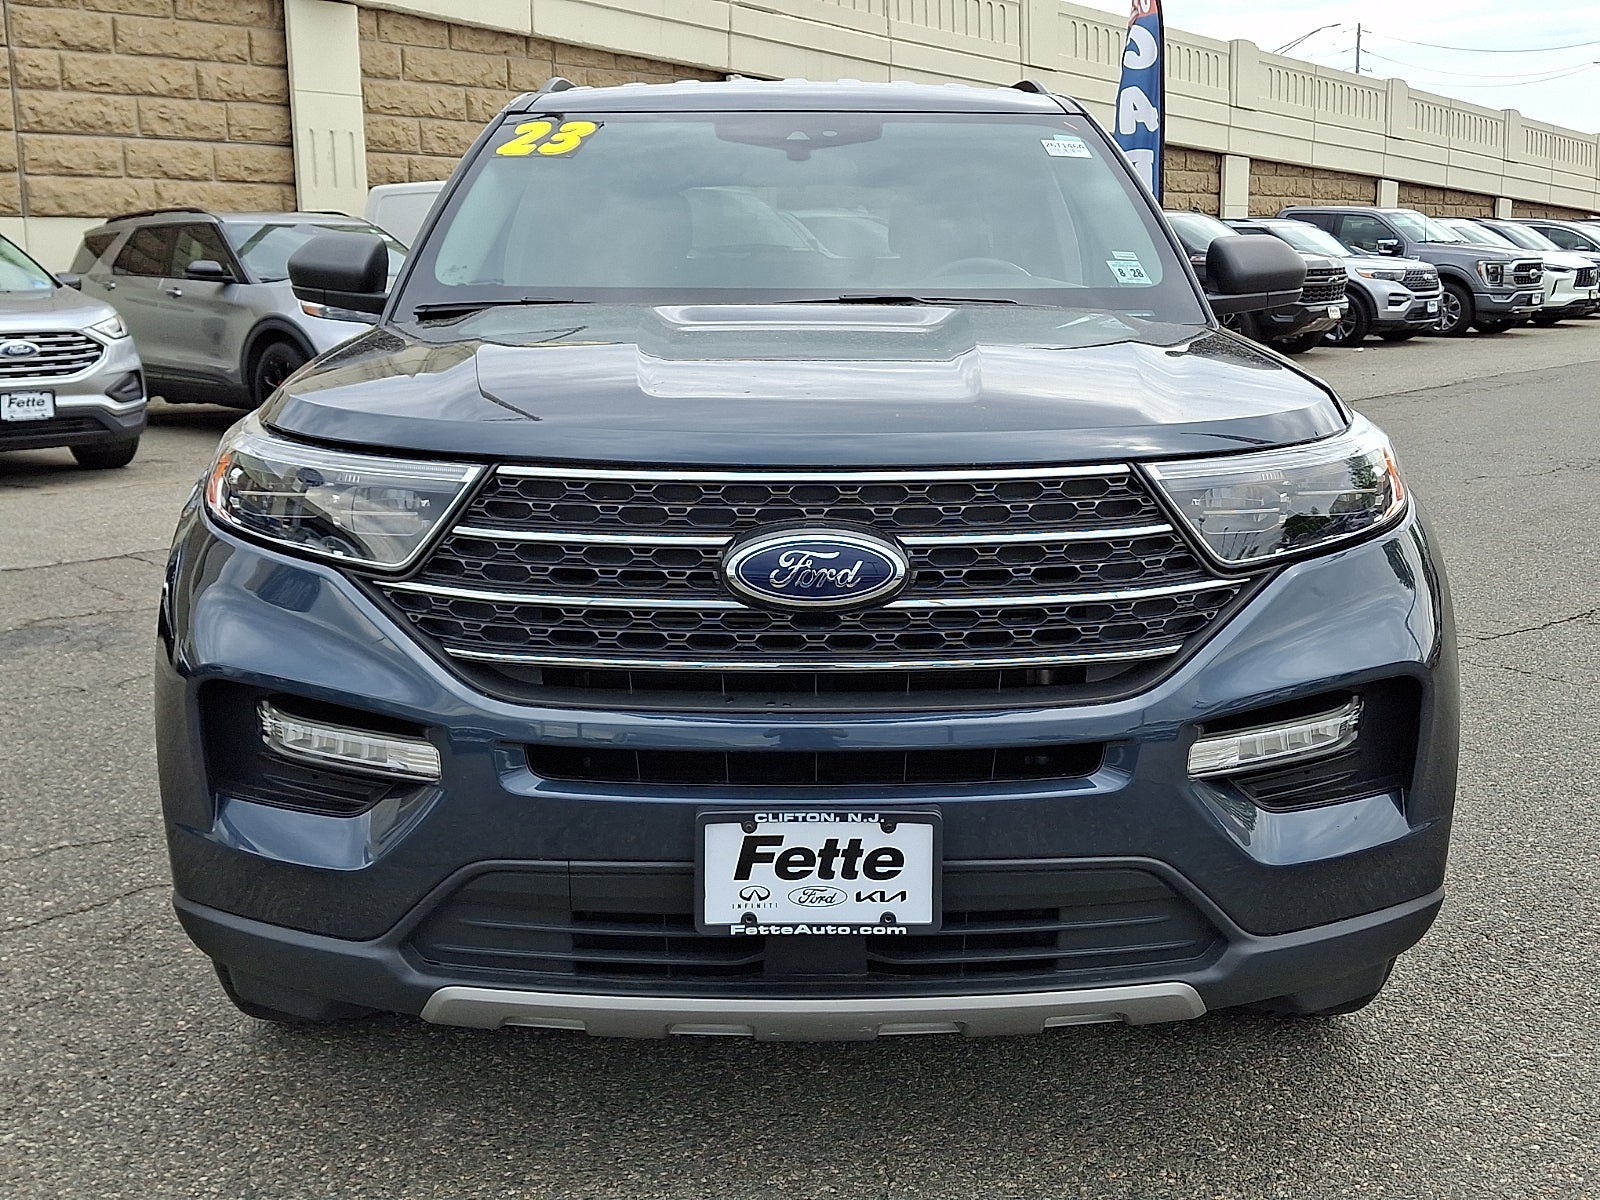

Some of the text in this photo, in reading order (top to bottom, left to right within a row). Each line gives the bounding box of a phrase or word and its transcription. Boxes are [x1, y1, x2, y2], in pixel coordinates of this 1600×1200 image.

[495, 120, 597, 156] 23
[1117, 268, 1144, 278] 8 28
[7, 396, 46, 408] Fette
[769, 550, 863, 588] Ford
[754, 813, 885, 823] CLIFTON, N.J.
[733, 834, 905, 881] Fette
[798, 887, 838, 904] Ford
[855, 890, 907, 903] KIA
[730, 924, 907, 936] FetteAuto.com
